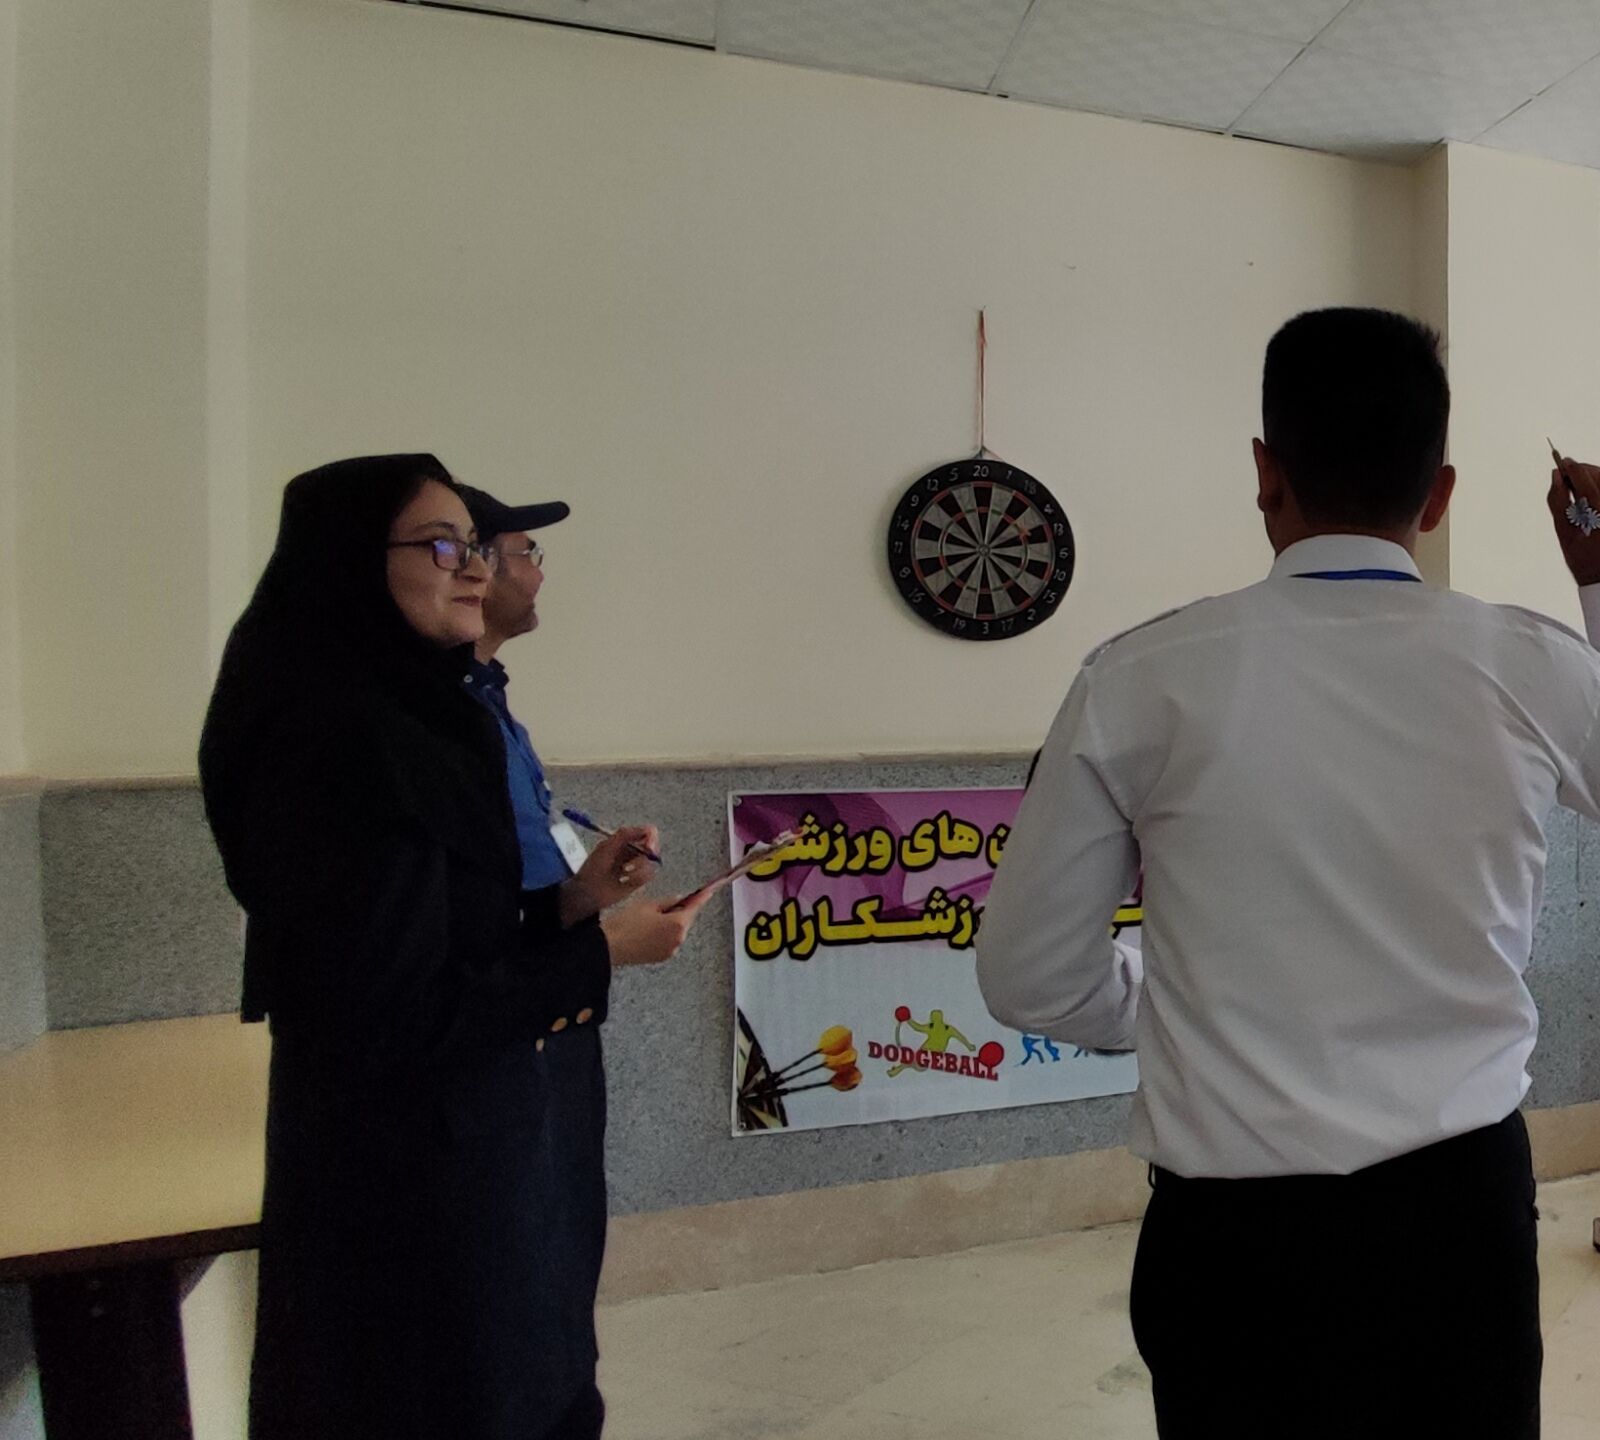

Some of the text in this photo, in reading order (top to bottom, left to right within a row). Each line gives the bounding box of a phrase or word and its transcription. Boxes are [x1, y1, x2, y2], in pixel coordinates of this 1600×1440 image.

[950, 468, 959, 481] 5
[973, 465, 989, 477] 20
[1006, 470, 1012, 479] 1
[926, 479, 939, 491] 12
[1024, 480, 1037, 494] 18
[911, 495, 919, 507] 9
[1044, 504, 1054, 514] 4
[897, 516, 910, 530] 14
[1054, 523, 1063, 535] 13
[1059, 547, 1069, 559] 6
[1054, 569, 1066, 580] 10
[909, 588, 925, 603] 16
[1043, 590, 1056, 603] 15
[1028, 609, 1036, 620] 2
[953, 617, 966, 630] 19
[983, 623, 989, 634] 3
[1001, 618, 1014, 631] 17
[746, 813, 893, 879] ورزشی
[901, 812, 982, 870] های
[746, 888, 976, 959] زشکاران
[868, 1041, 998, 1081] DODGEBALL
